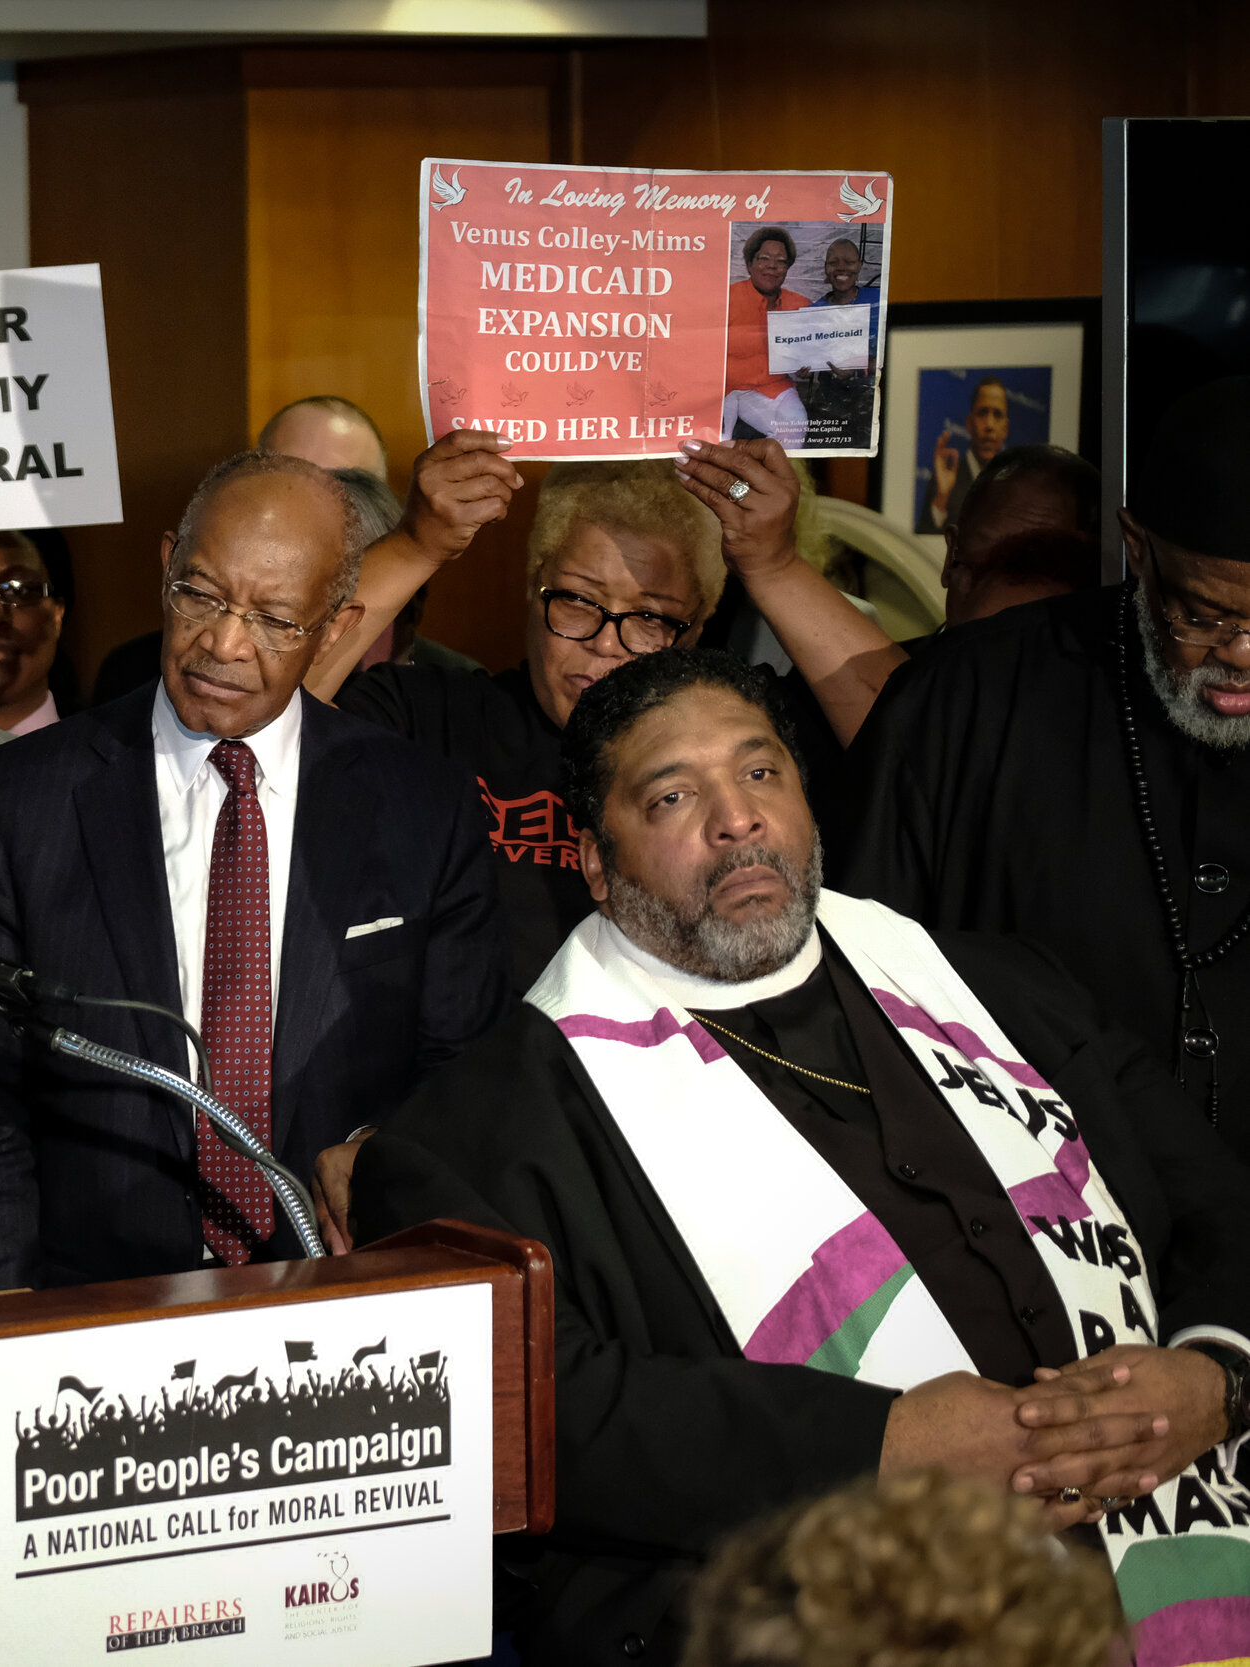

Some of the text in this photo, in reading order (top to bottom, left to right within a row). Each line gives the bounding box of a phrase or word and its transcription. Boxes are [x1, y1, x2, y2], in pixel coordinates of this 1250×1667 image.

[504, 178, 771, 218] In Loving Memory of
[450, 221, 706, 256] Venus Colley-Mims
[480, 261, 672, 296] MEDICAID
[477, 307, 672, 339] EXPANSION
[775, 329, 863, 344] Expand Medicaid!
[505, 350, 642, 373] COULD'VE
[556, 416, 621, 441] HER
[629, 415, 694, 439] LIFE
[932, 1048, 1080, 1142] JEUS
[23, 1422, 442, 1508] Poor People's Campaign
[23, 1480, 444, 1560] A NATIONAL CALL for MORAL REVIVAL
[285, 1577, 359, 1608] KAIROS
[110, 1597, 243, 1634] REPAIRERS
[109, 1618, 243, 1650] OF THE BREACH
